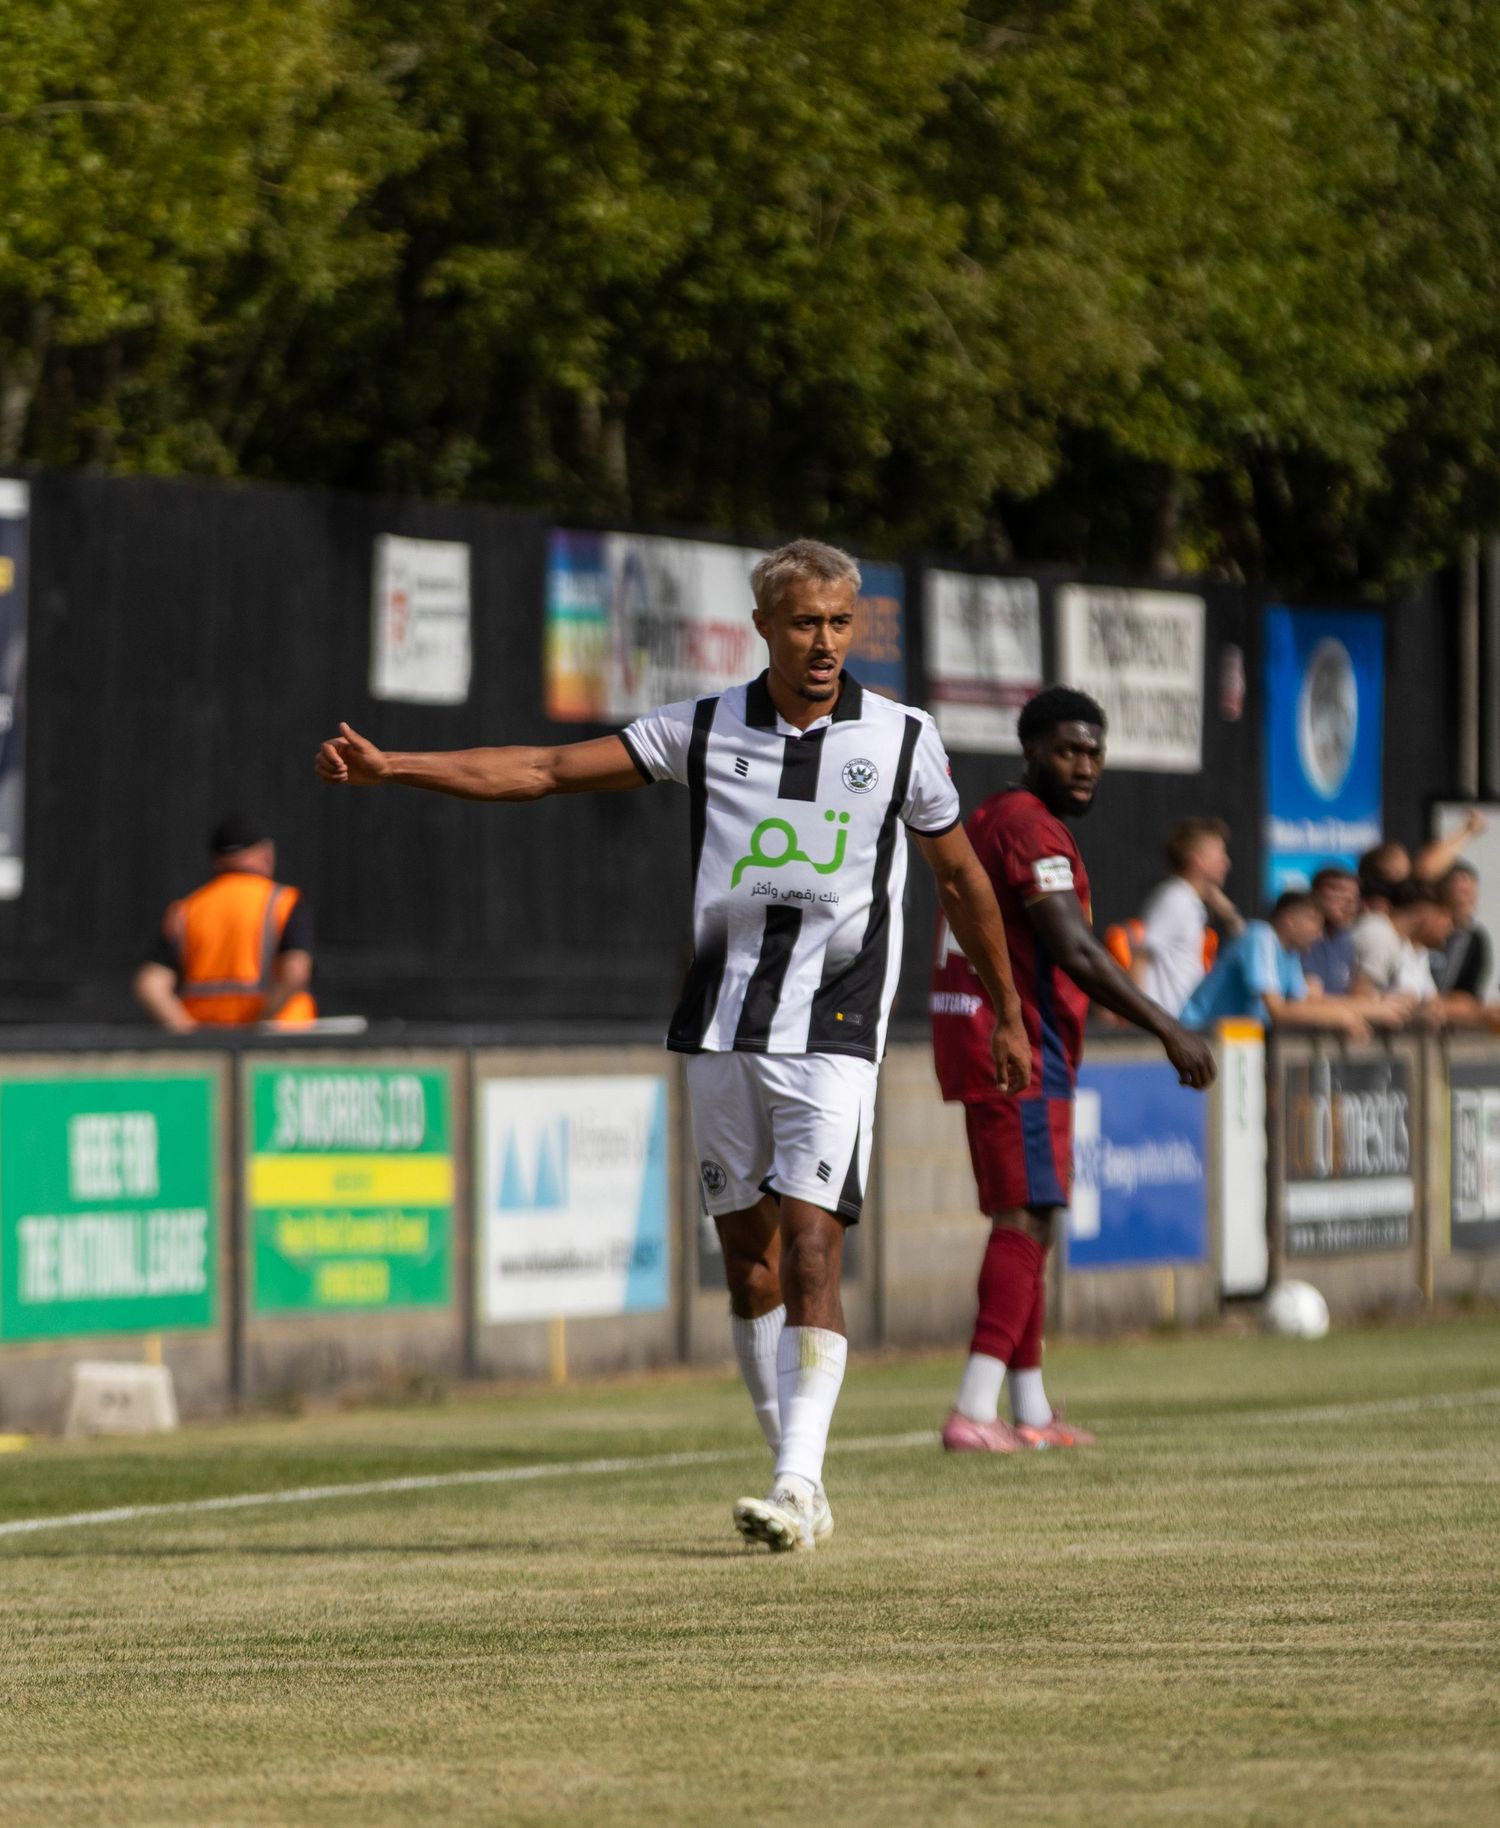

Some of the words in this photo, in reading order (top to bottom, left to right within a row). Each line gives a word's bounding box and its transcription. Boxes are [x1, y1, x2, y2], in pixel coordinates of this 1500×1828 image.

[751, 881, 778, 899] وأكثر
[781, 888, 816, 903] رقمي
[819, 892, 840, 906] بنك
